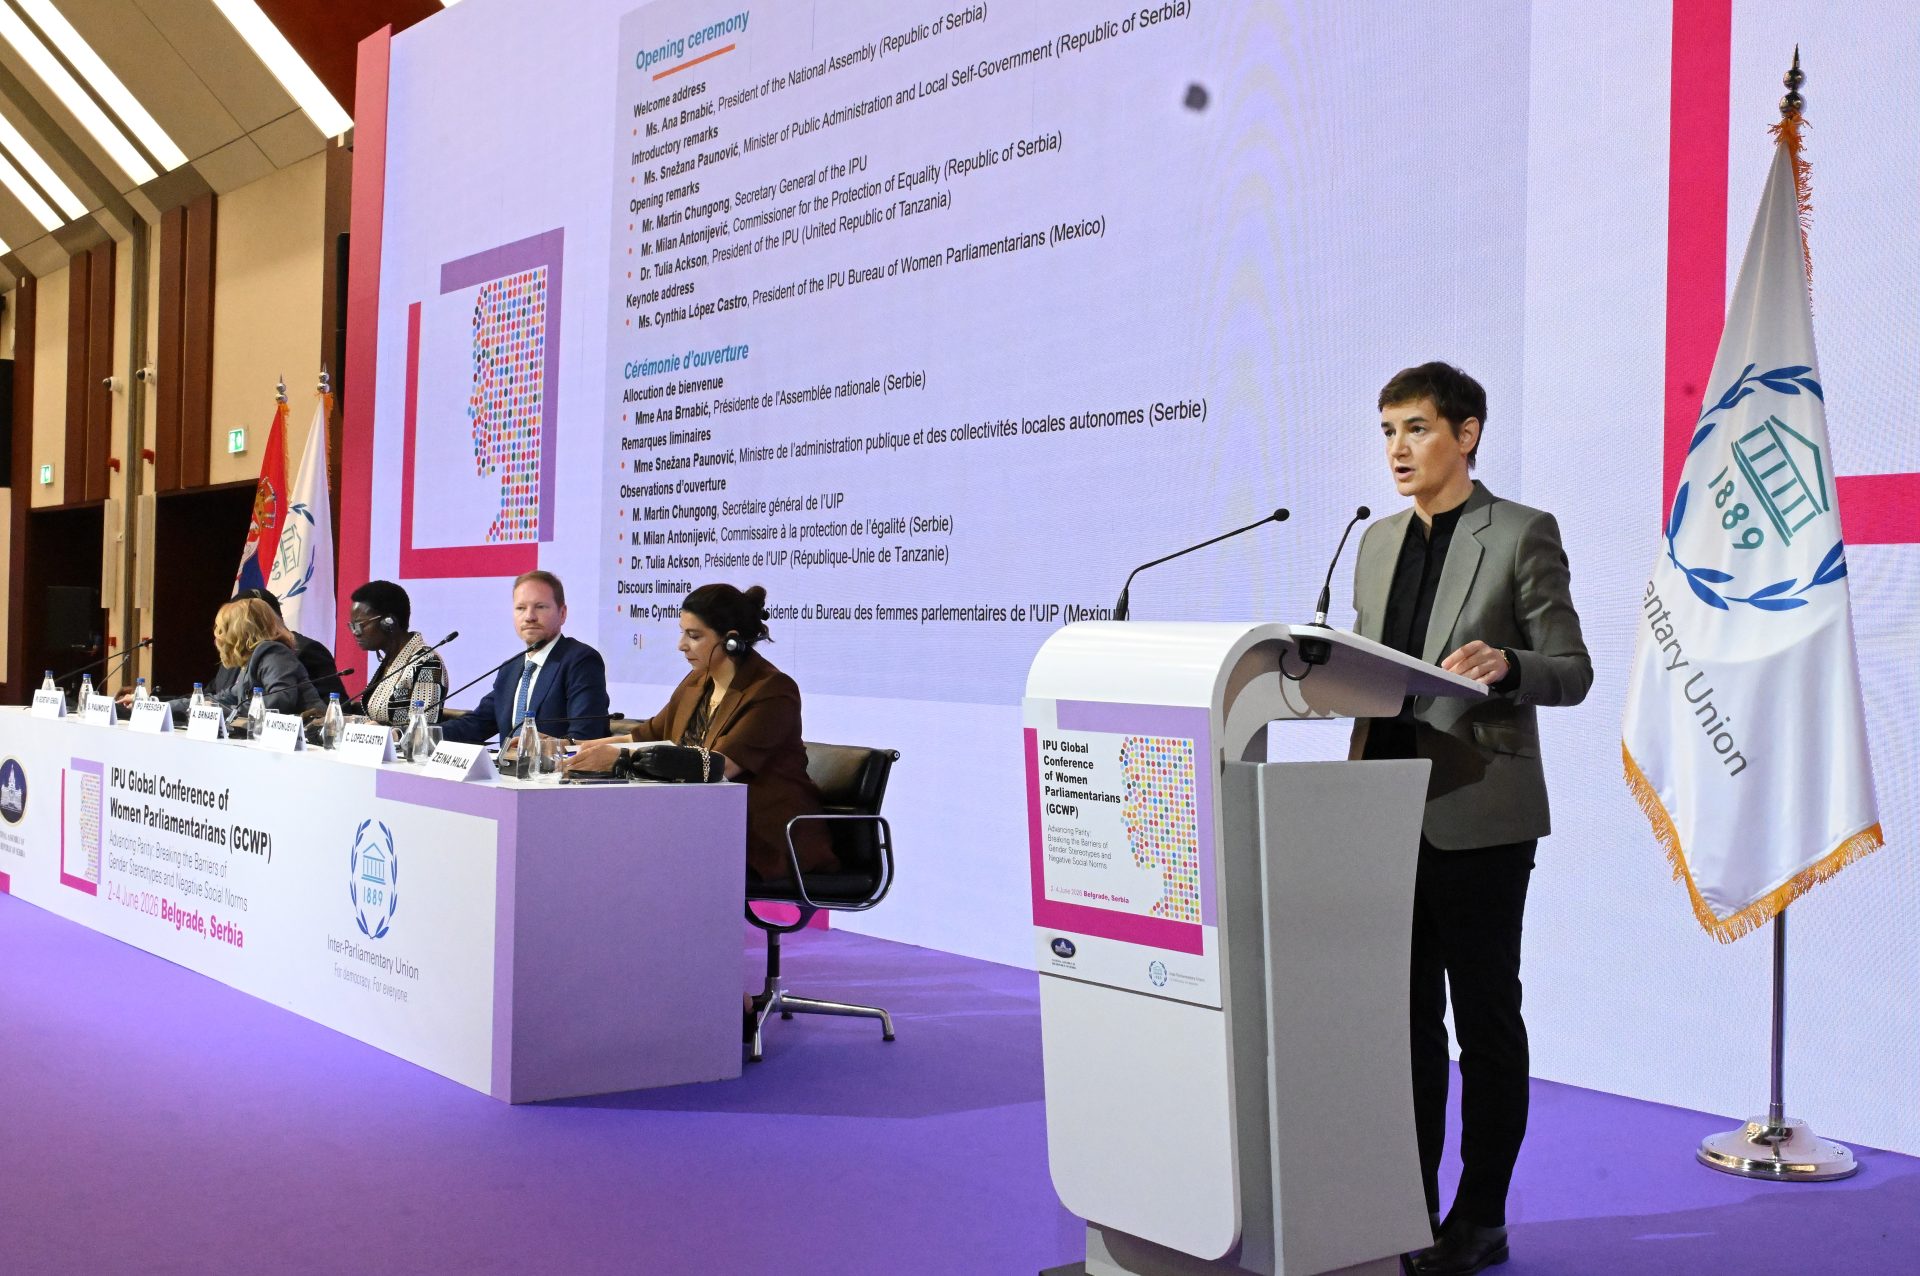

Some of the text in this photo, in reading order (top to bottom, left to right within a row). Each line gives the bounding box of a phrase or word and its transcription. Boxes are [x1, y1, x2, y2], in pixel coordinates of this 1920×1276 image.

[636, 11, 749, 71] Opening ceremony
[646, 2, 987, 137] Ms. Ana Brnabić, President of the National Assembly (Republic of Serbia)
[634, 82, 706, 118] Welcome address
[644, 0, 1191, 185] Ms. Snežana Paunović, Minister of Public Administration and Local Self-Government (Republic of Serbia)
[632, 126, 718, 165] Introductory remarks
[630, 181, 699, 214] Opening remarks
[642, 155, 867, 232] Mr. Martin Chungong, Secretary General of the IPU
[639, 215, 1105, 329] Ms. Cynthia López Castro, President of the IPU Bureau of Women Parliamentarians (Mexico)
[627, 282, 694, 309] Keynote address
[625, 354, 680, 379] Cérémonie
[623, 377, 723, 403] Allocution de bienvenue
[636, 411, 654, 425] Mme
[656, 408, 672, 422] Ana
[675, 402, 711, 419] Brnabić,
[714, 395, 759, 414] Présidente
[762, 393, 773, 408] de
[835, 377, 880, 398] nationale
[884, 370, 925, 395] (Serbie)
[622, 430, 711, 451] Remarques liminaires
[620, 483, 673, 498] Observations
[1707, 466, 1765, 551] 1889
[632, 532, 641, 545] M.
[644, 531, 665, 545] Milan
[667, 528, 718, 547] Antonijević,
[721, 527, 778, 541] Commissaire
[781, 524, 786, 538] à
[789, 523, 797, 538] la
[800, 521, 847, 542] protection
[851, 520, 863, 535] de
[910, 515, 953, 537] (Serbie)
[618, 579, 692, 594] Discours liminaire
[198, 711, 218, 721] BRNABIC
[1684, 671, 1747, 777] Union
[351, 733, 384, 746] LOPEZ-CASTRO
[1042, 740, 1089, 754] IPU Global
[432, 752, 469, 770] ZEINA HILAL
[1043, 756, 1094, 770] Conference
[111, 767, 229, 811] IPU Global Conference of
[1044, 770, 1088, 785] of Women
[1045, 786, 1121, 804] Parliamentarians
[1045, 803, 1079, 819] (GCWP)
[110, 797, 272, 864] Women Parliamentarians (GCWP)
[363, 886, 383, 906] 1889
[1083, 891, 1110, 901] Belgrade,
[1111, 895, 1129, 904] Serbia
[161, 898, 207, 940] Belgrade,
[210, 914, 243, 948] Serbia
[328, 934, 419, 980] Inter-Parliamentary Union
